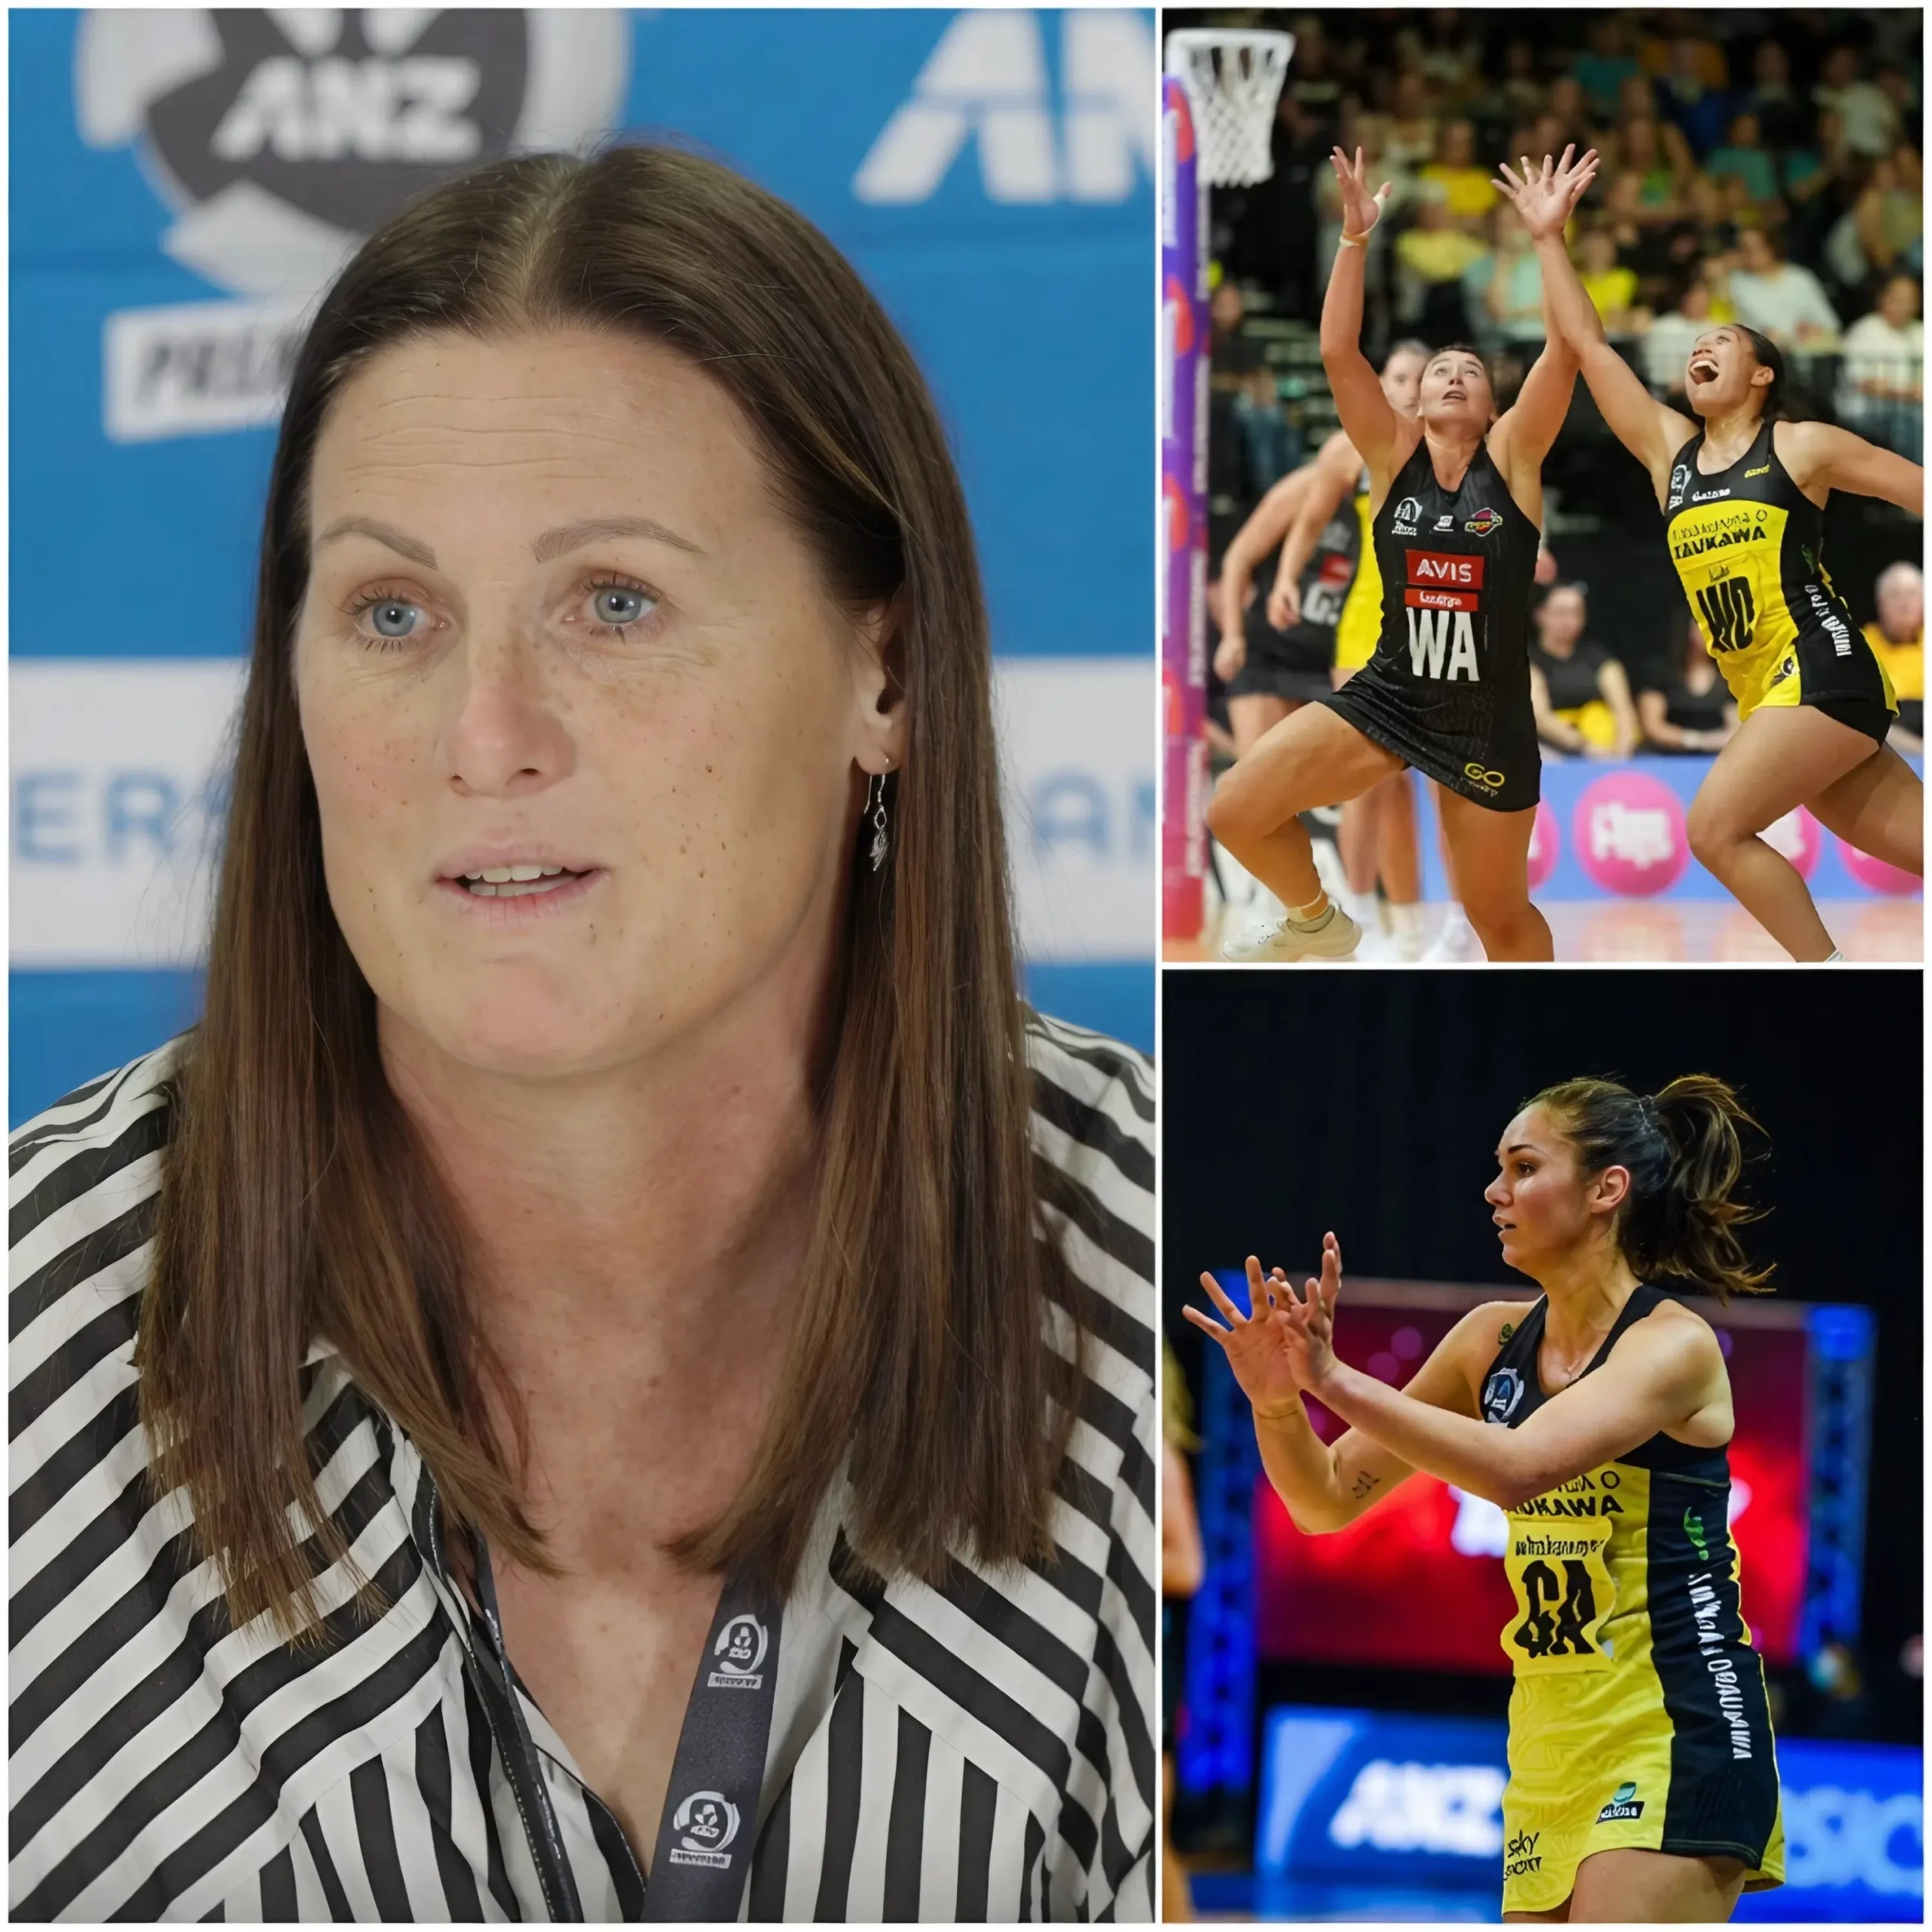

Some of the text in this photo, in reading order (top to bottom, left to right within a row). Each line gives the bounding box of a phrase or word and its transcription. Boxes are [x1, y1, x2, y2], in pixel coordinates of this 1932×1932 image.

[211, 54, 483, 162] ANZ
[1417, 558, 1472, 583] AVIS
[1406, 606, 1480, 681] WA
[15, 766, 234, 868] ER
